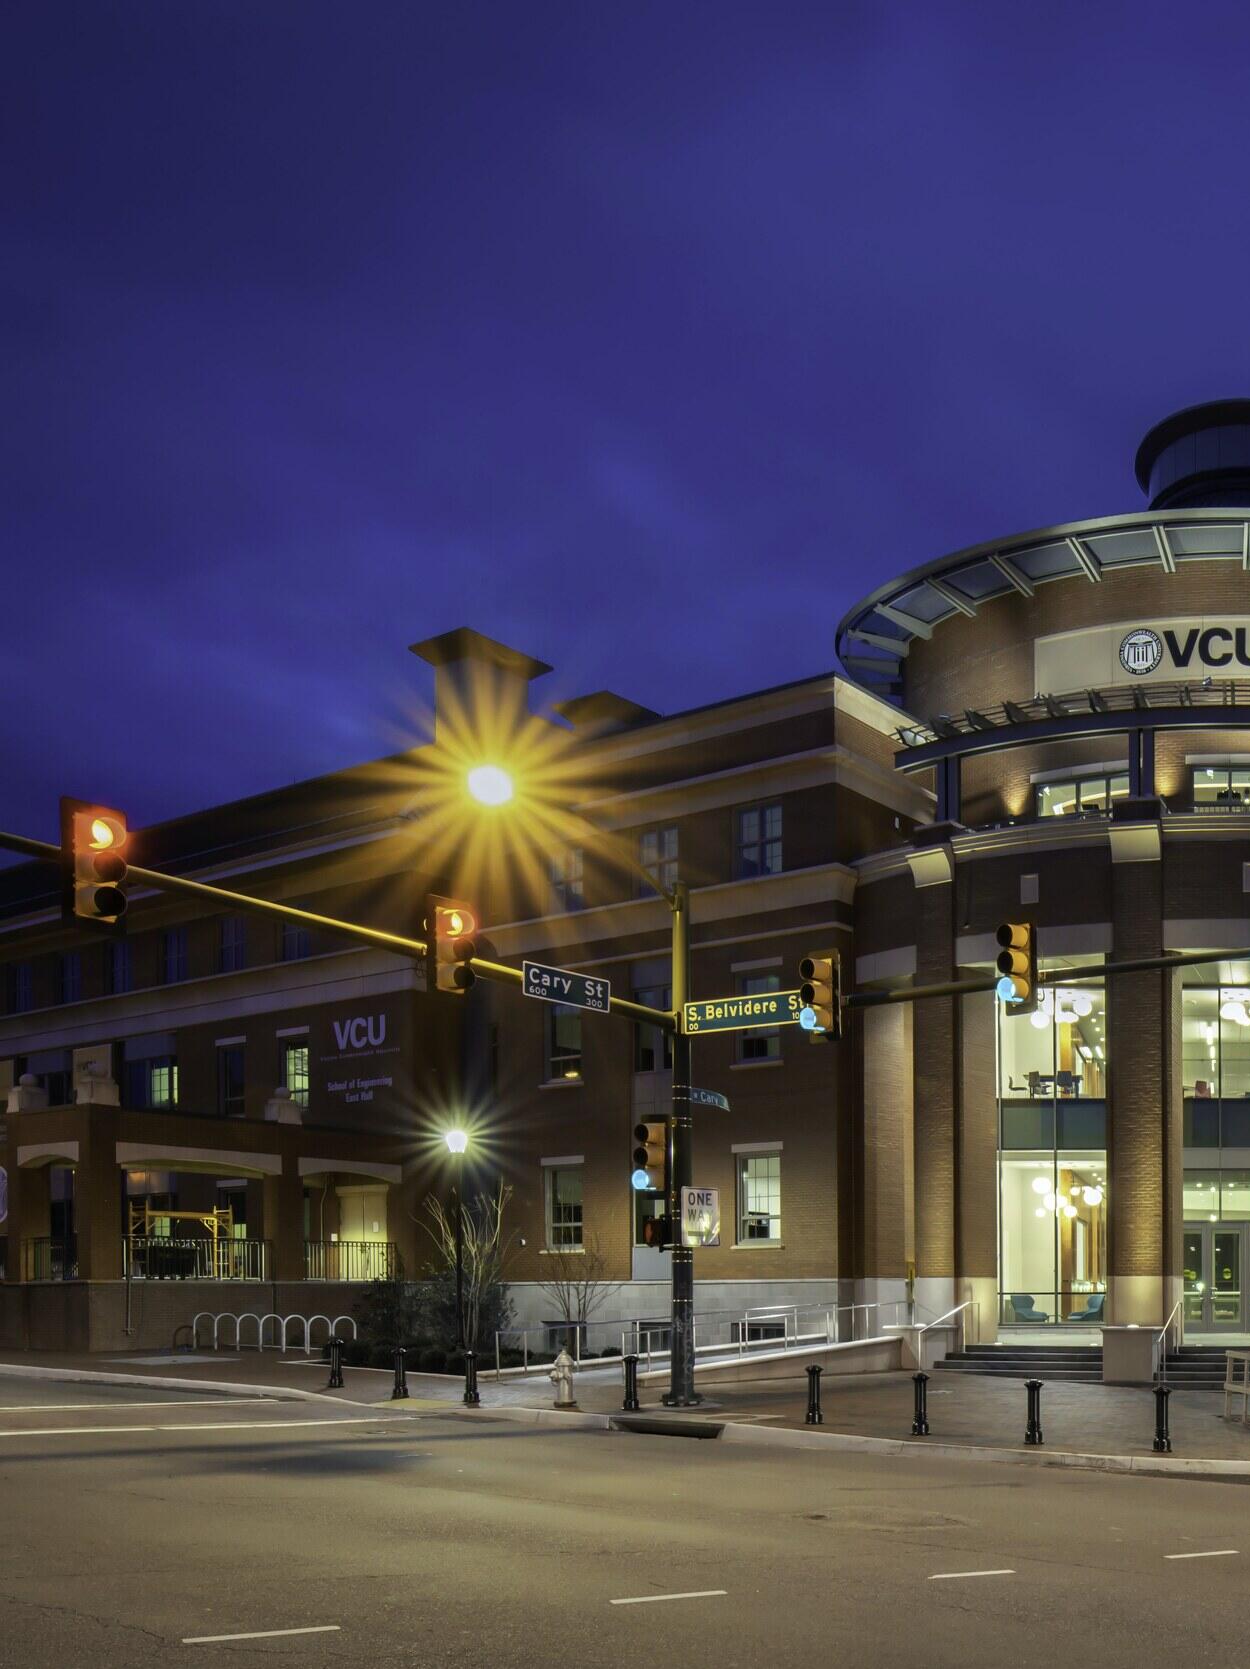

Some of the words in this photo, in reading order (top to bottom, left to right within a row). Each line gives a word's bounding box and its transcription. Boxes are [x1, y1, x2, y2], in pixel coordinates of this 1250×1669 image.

[529, 967, 572, 994] Cary
[584, 980, 604, 998] St
[529, 985, 547, 996] 600
[586, 997, 603, 1008] 300
[688, 1006, 702, 1021] S.
[705, 1000, 777, 1020] Belvidere
[791, 1011, 800, 1020] 10
[333, 1014, 386, 1050] VCU
[327, 1081, 347, 1091] School
[348, 1080, 355, 1089] of
[357, 1077, 393, 1089] Engineering
[345, 1092, 360, 1103] East
[361, 1089, 374, 1101] Hall
[700, 1091, 719, 1105] Cary
[687, 1192, 713, 1207] ONE
